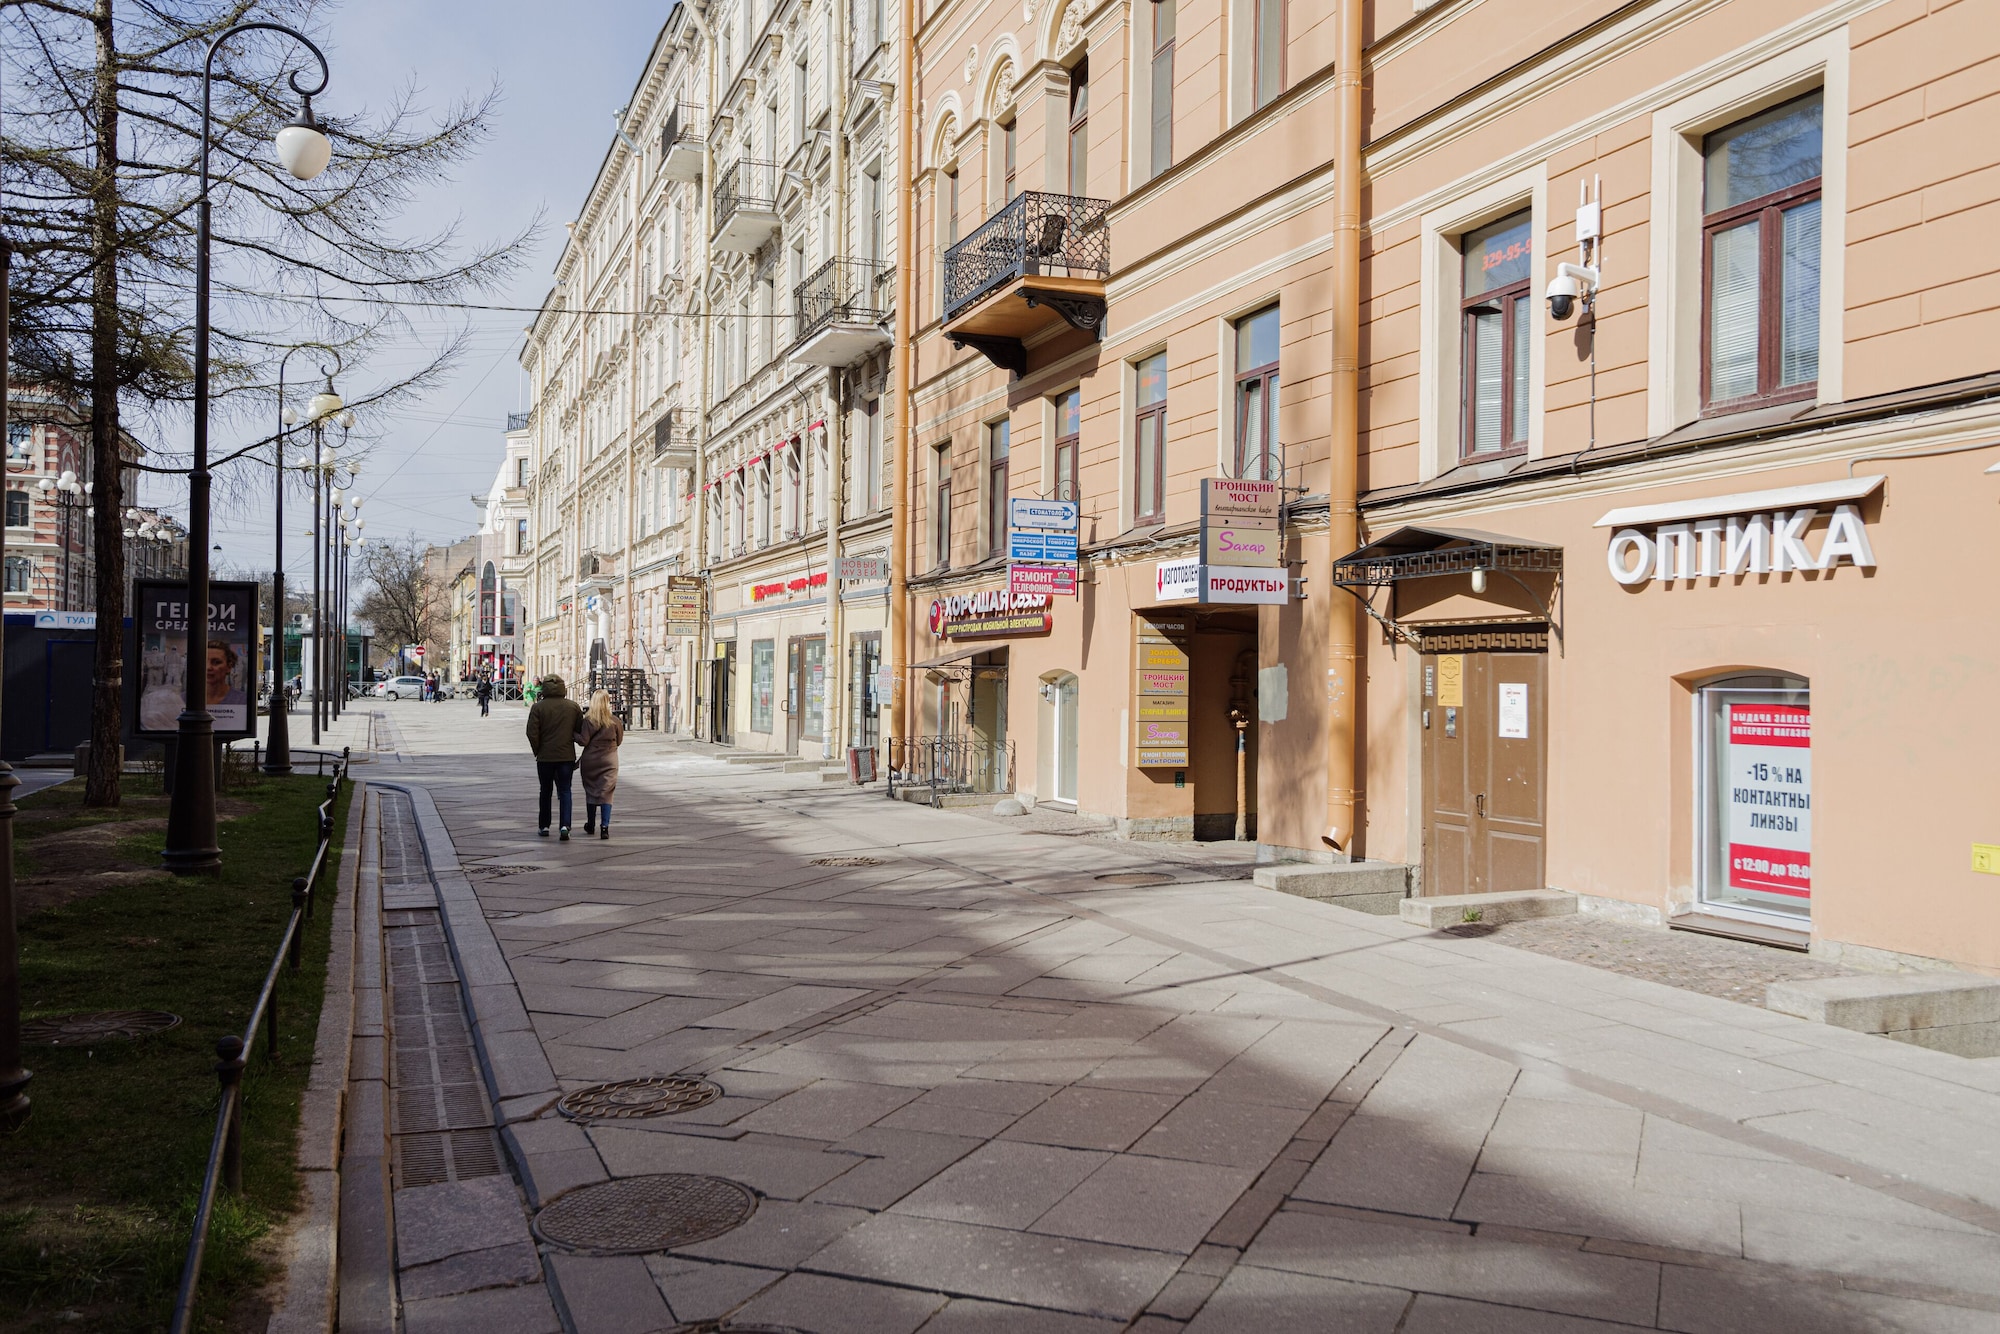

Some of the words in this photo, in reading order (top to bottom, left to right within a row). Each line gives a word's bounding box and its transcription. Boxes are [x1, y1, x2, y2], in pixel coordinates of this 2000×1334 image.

[1214, 481, 1274, 492] ТРОИЦКИЙ
[1228, 493, 1259, 503] МОСТ
[1031, 509, 1071, 517] СТОМАТОЛОГИЯ
[1607, 505, 1876, 584] ОПТИКА
[841, 559, 877, 568] НОВЫЙ
[841, 569, 877, 577] МУЗЕЙ
[1013, 571, 1053, 583] РЕМОНТ
[1013, 583, 1053, 593] ТЕЛЕФОНОВ
[1210, 578, 1277, 593] ПРОДУКТЫ
[945, 589, 1008, 616] ХОРОШАЯ
[156, 602, 236, 620] ГЕОИ
[65, 616, 94, 624] ТУАЛ
[946, 624, 959, 634] ЦЕНТР
[959, 623, 982, 633] РАСПРОДАЖ
[982, 618, 1009, 631] МОБИЛЬНОЙ
[1009, 617, 1043, 629] ЭЛЕКТРОНИКИ
[155, 620, 188, 632] СРЕД
[1143, 673, 1185, 681] ТРОИЦКИЙ
[1732, 712, 1771, 723] ВЫДАЧА
[1732, 726, 1771, 736] ИНТЕРНЕТ
[1747, 763, 1768, 781] -15
[1772, 766, 1783, 782] %
[1786, 767, 1803, 783] НА
[1750, 812, 1798, 832] ЛИНЗЫ
[1742, 857, 1769, 873] 12:00
[1769, 863, 1786, 877] до
[1786, 863, 1810, 879] 19:0
